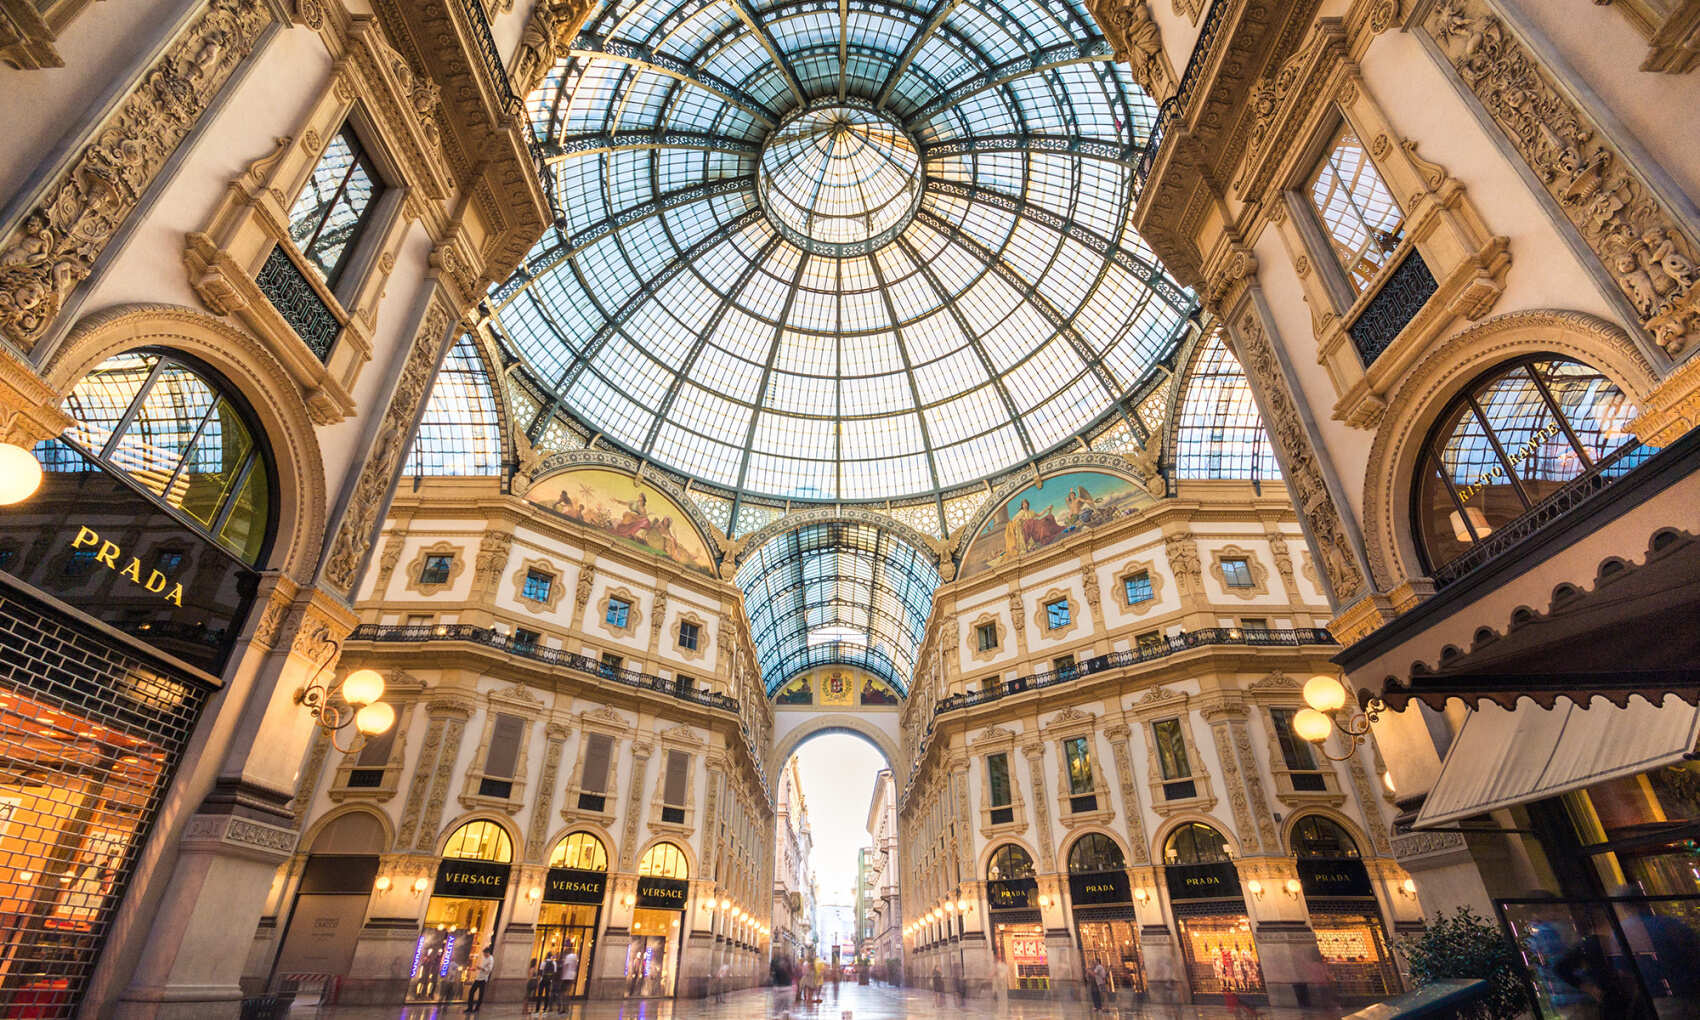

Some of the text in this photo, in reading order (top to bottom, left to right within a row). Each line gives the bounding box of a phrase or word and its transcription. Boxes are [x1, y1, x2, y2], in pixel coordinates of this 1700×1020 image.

[71, 525, 183, 608] PRADA
[445, 872, 501, 886] VERSACE
[1186, 876, 1220, 886] PRADA
[1314, 873, 1351, 881] PRADA
[552, 880, 600, 893] VERSACE
[1086, 883, 1115, 893] PRADA
[642, 887, 683, 899] VERSACE
[1001, 889, 1026, 899] PRADA
